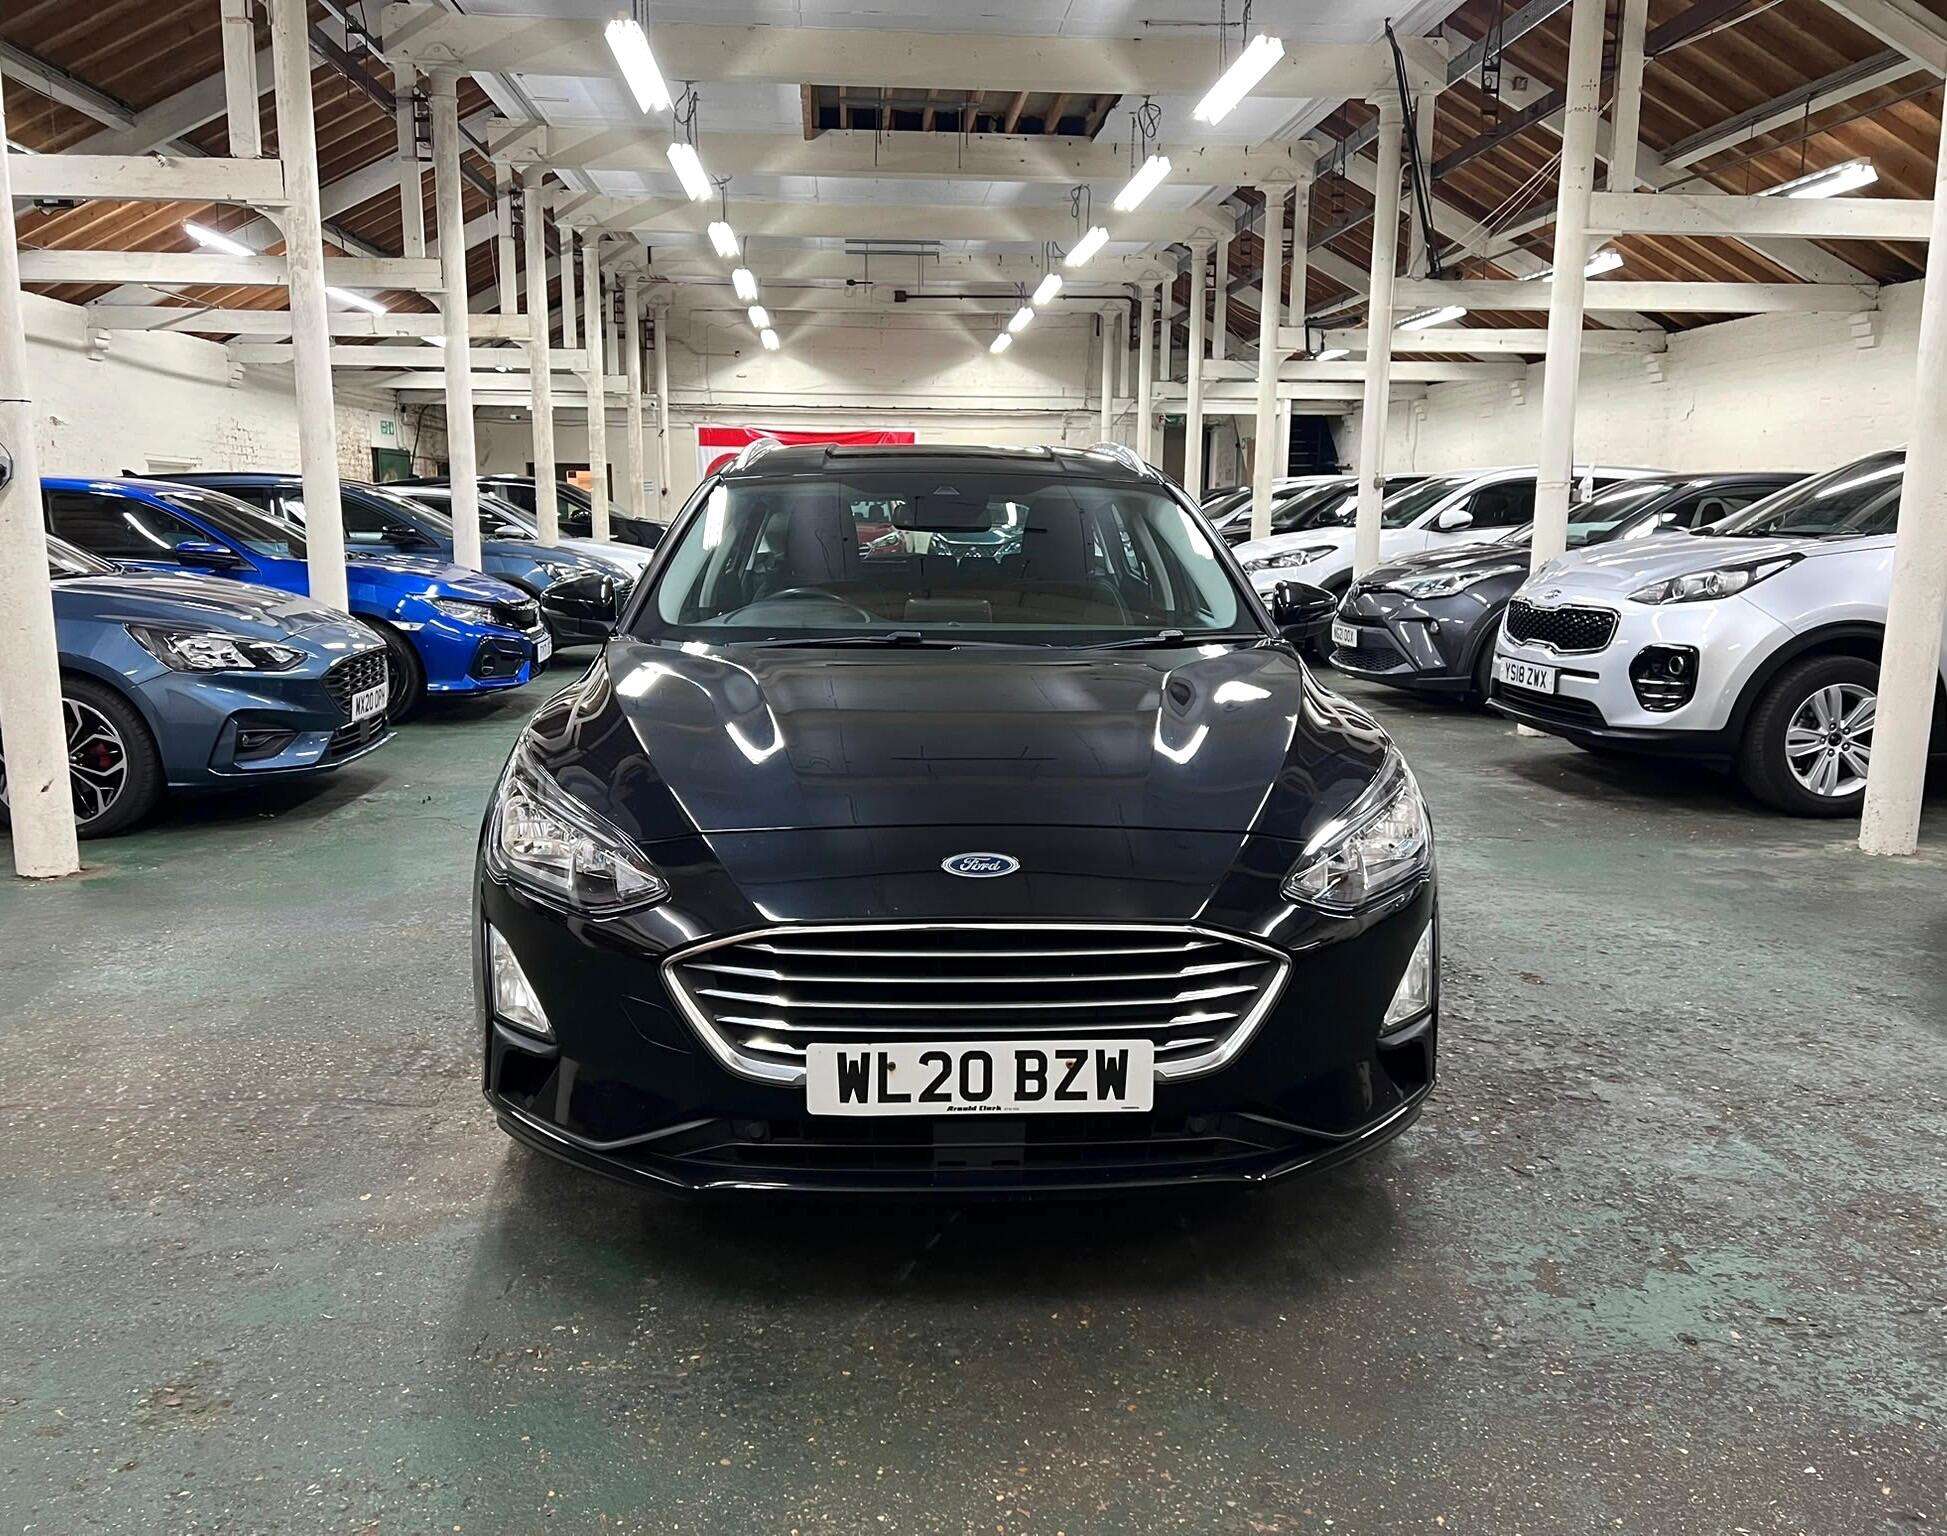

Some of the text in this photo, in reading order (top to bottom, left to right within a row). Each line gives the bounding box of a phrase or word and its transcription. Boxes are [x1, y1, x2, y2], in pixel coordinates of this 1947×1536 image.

[1505, 661, 1547, 689] YS18 ZWX
[959, 857, 1001, 871] Ford
[837, 1049, 1129, 1104] WL20 BZW
